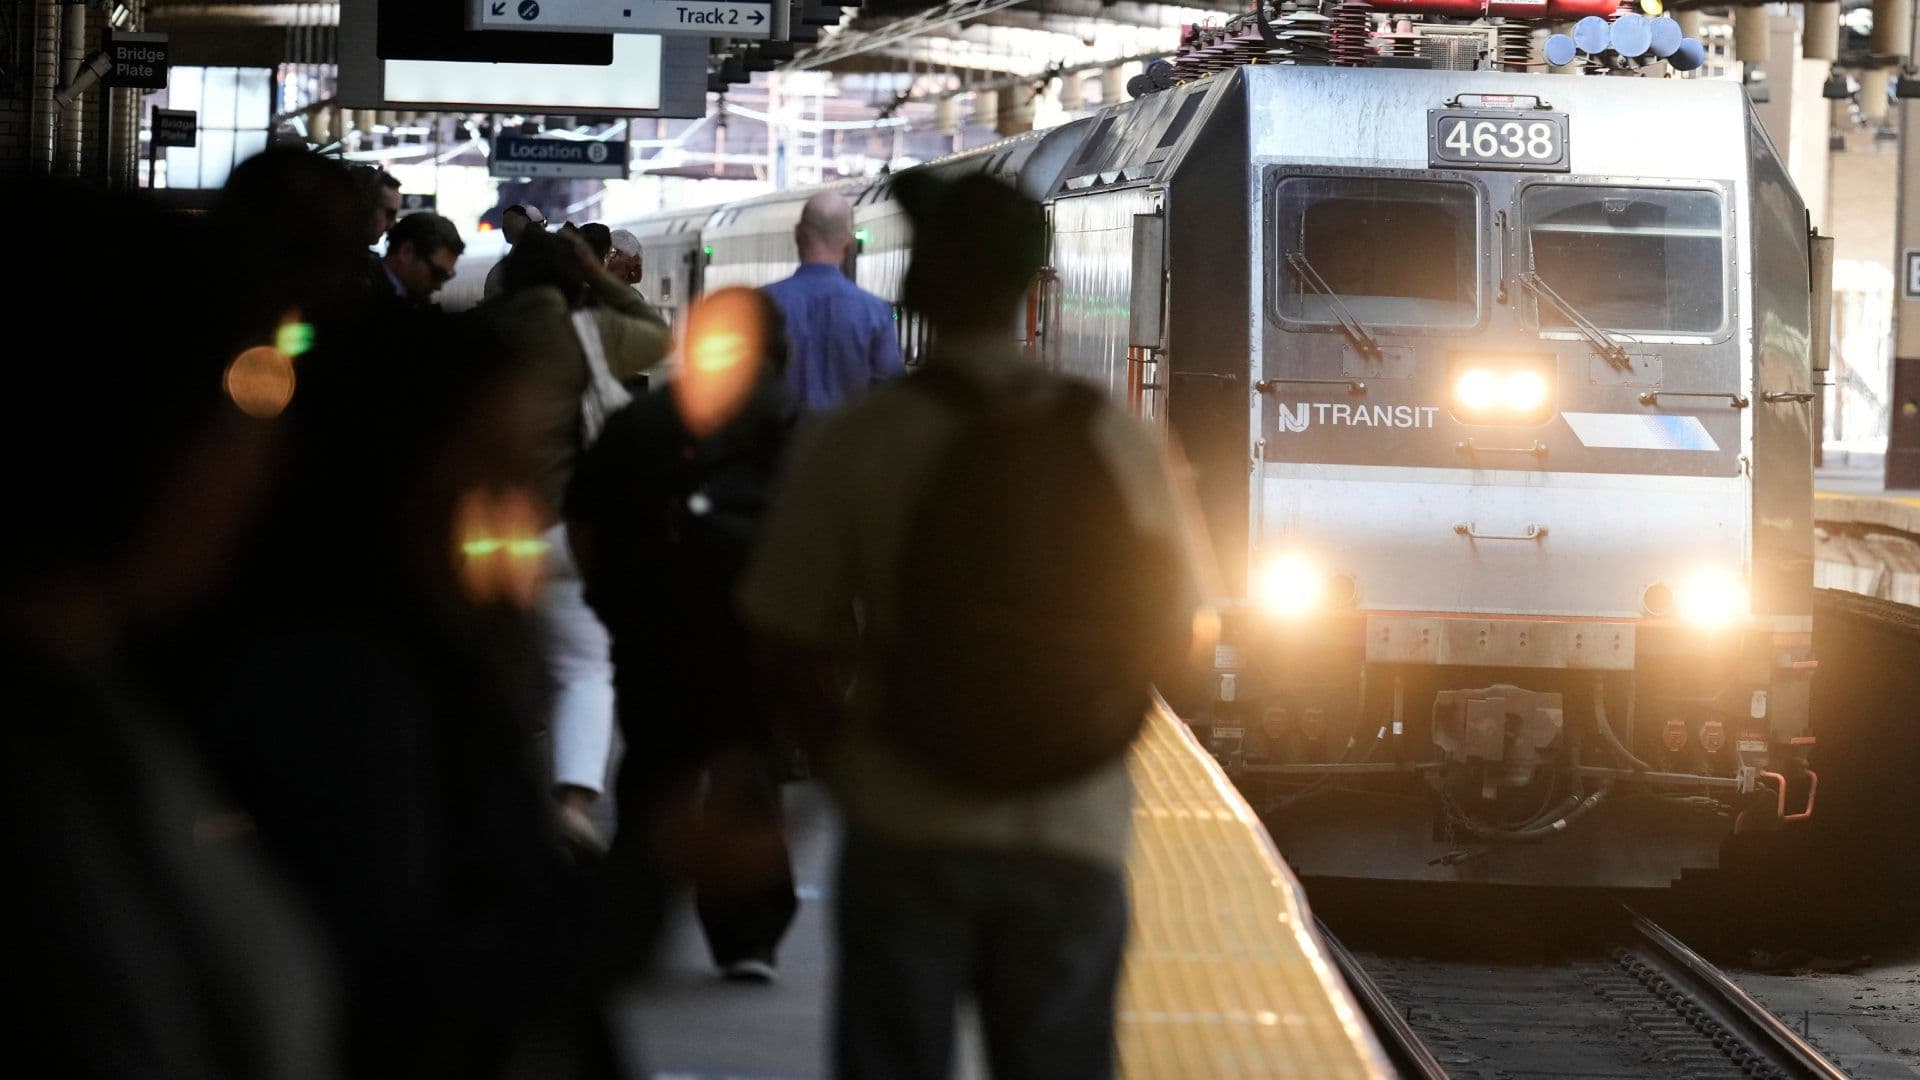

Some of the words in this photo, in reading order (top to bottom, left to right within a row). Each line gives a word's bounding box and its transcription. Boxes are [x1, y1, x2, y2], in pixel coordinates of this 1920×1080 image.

[676, 7, 724, 24] Track
[728, 9, 739, 24] 2
[116, 47, 165, 63] Bridge
[116, 63, 153, 76] Plate
[1445, 120, 1553, 159] 4638
[510, 142, 581, 159] Location
[1278, 402, 1310, 432] NJ
[1313, 403, 1440, 428] TRANSIT
